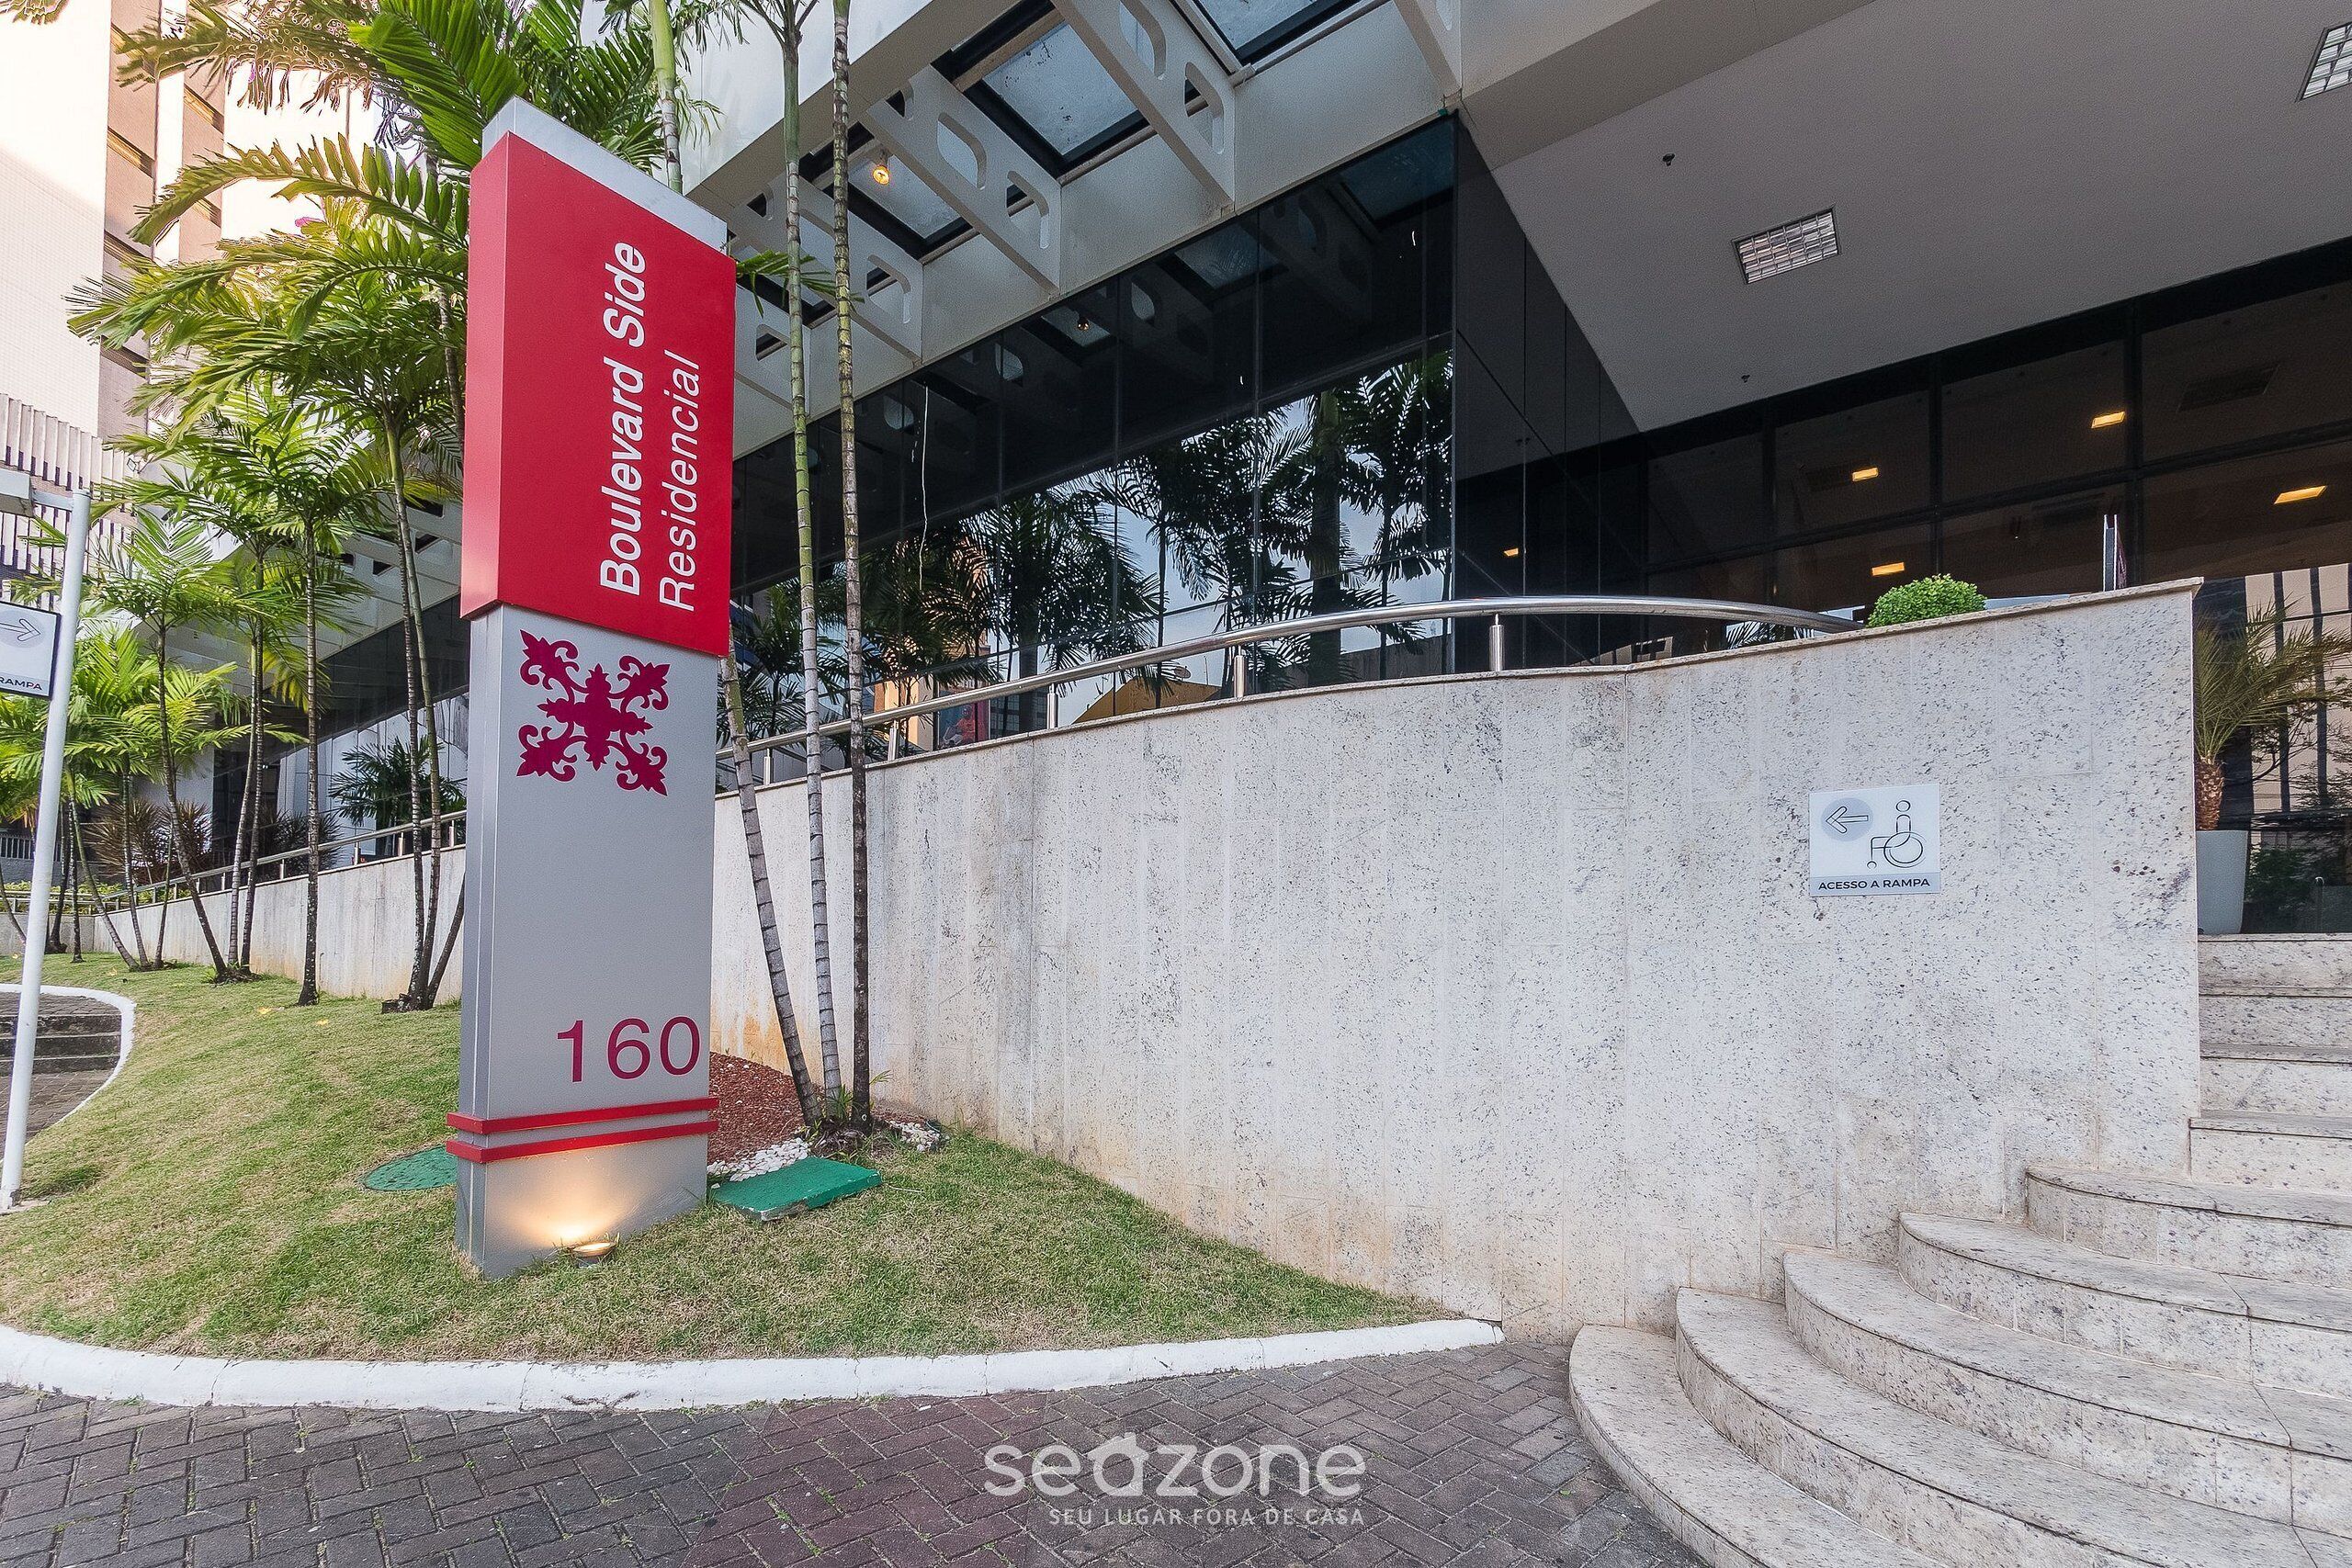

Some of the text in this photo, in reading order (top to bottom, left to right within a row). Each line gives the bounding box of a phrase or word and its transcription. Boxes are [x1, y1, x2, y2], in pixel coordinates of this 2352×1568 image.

[599, 241, 646, 595] Boulevard Side
[659, 349, 700, 612] Residencial
[1818, 878, 1930, 890] ACESSO A RAMPA
[557, 1015, 701, 1083] 160
